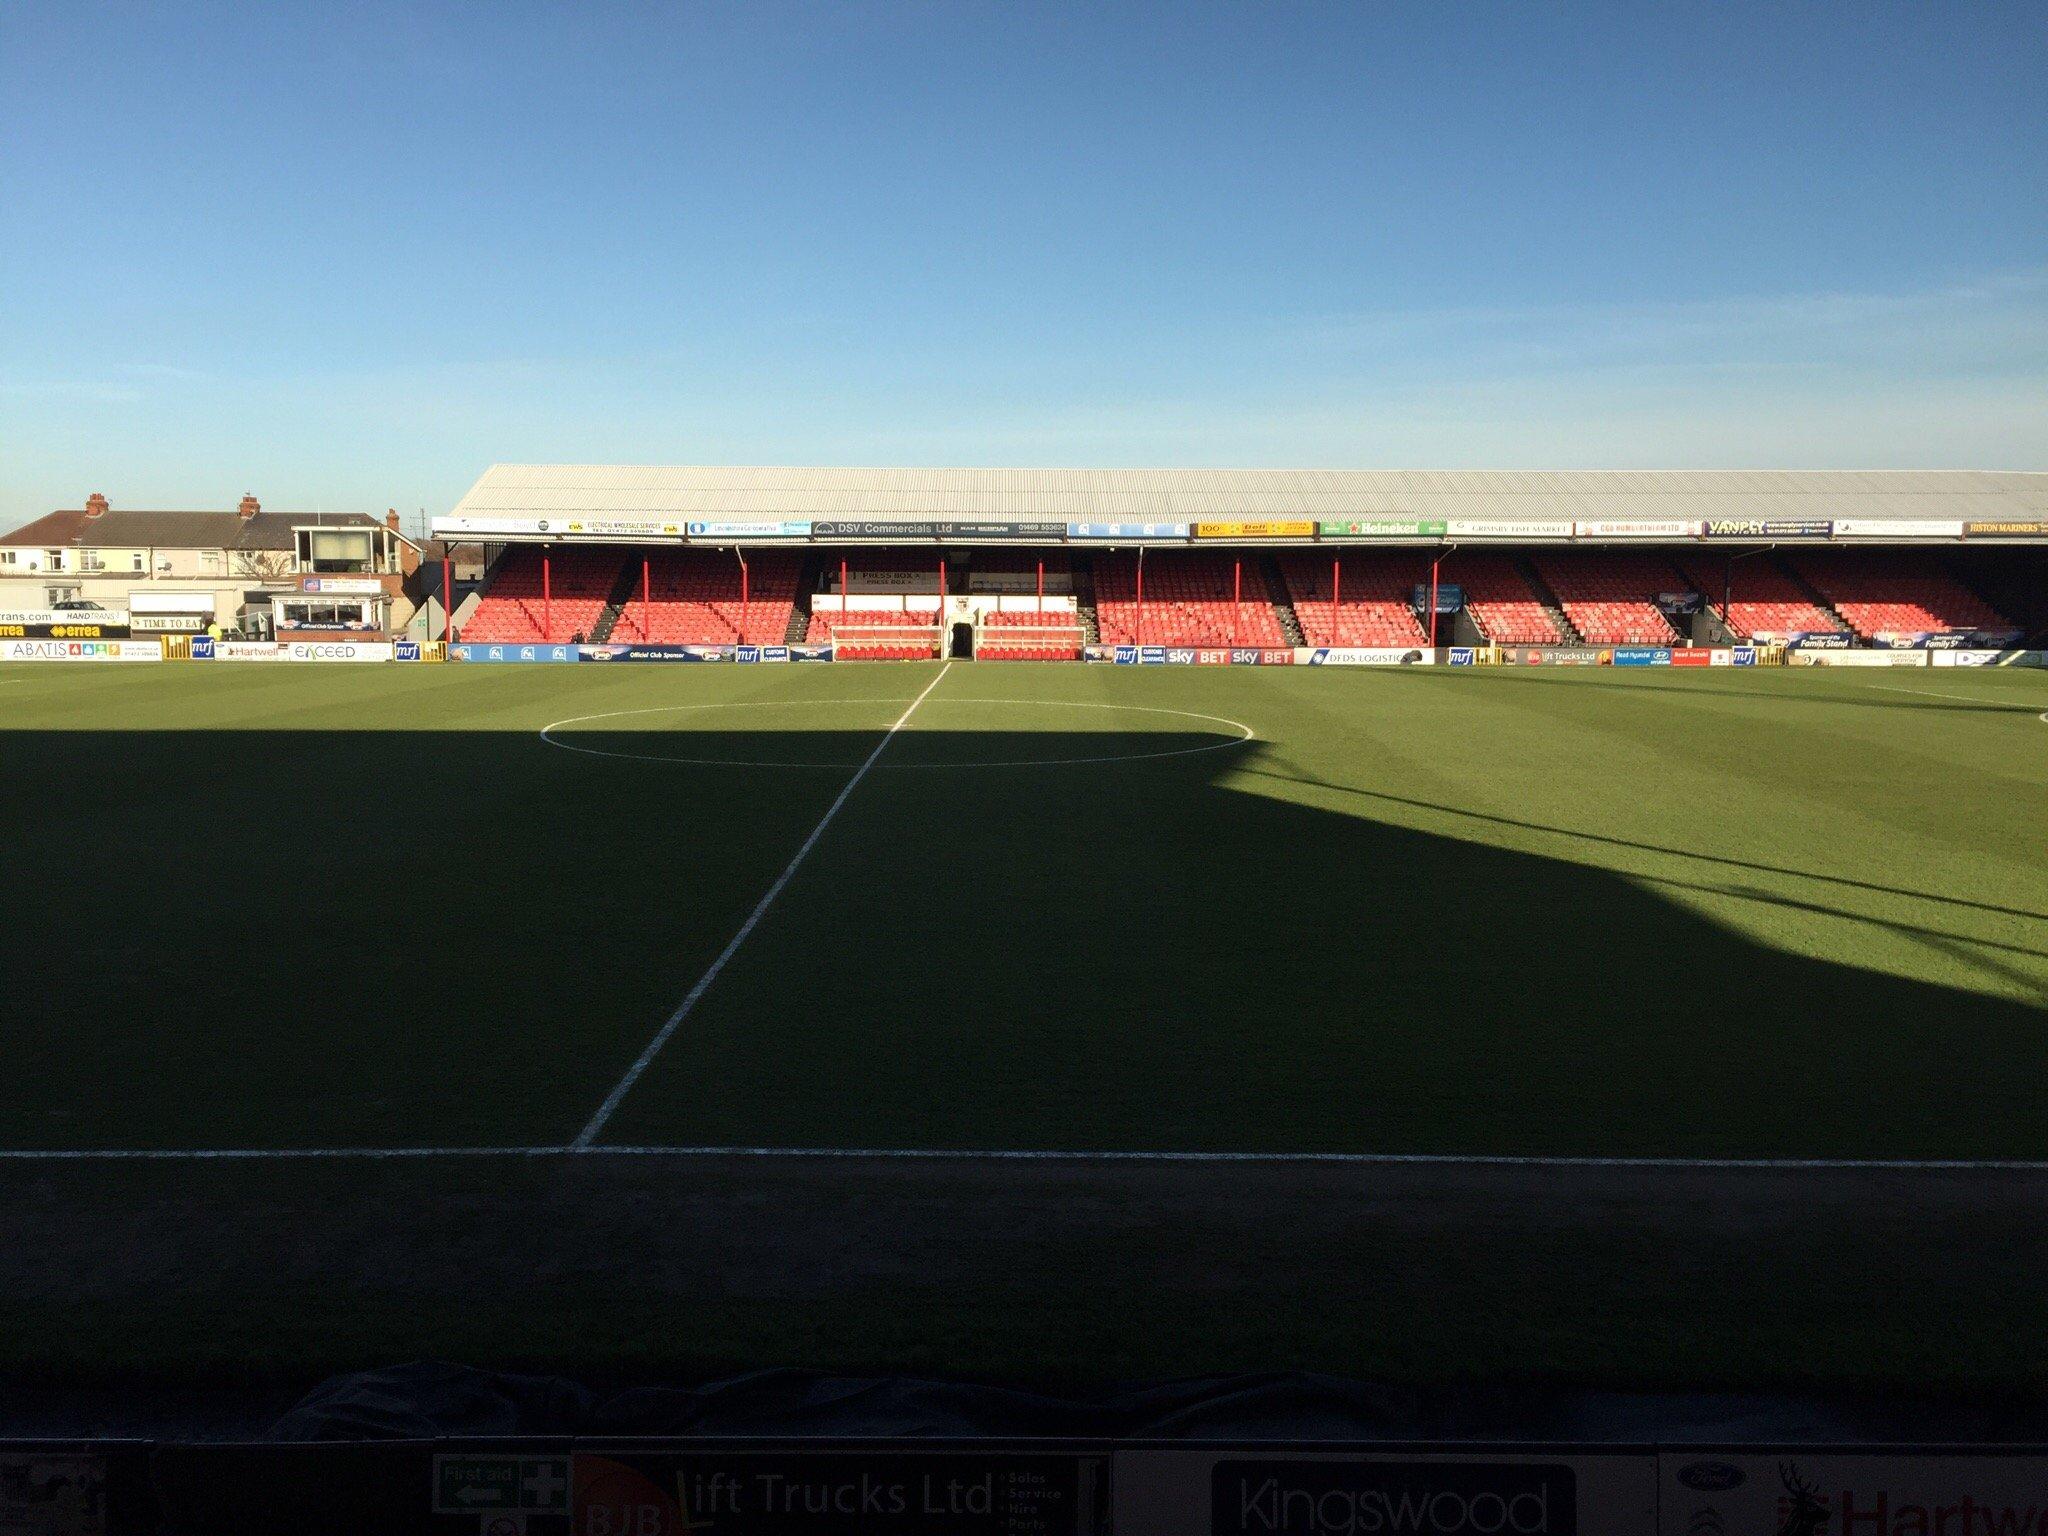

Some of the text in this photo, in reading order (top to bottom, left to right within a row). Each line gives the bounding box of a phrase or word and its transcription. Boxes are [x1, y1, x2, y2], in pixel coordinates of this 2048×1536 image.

[838, 523, 952, 533] DSV Commercials Ltd
[1361, 522, 1419, 534] Heineken
[1472, 525, 1507, 533] GRIMSBY
[1709, 521, 1764, 531] VANPLY
[1970, 523, 1998, 532] HISTON
[2000, 523, 2038, 532] MARINERS
[0, 612, 52, 621] rans.com
[144, 619, 164, 628] TIME
[169, 619, 182, 628] TO
[66, 626, 100, 637] errea
[13, 643, 66, 656] ABATIS
[192, 640, 214, 656] mrf
[1801, 640, 1825, 648] Family
[1925, 640, 1950, 648] Family
[236, 648, 278, 657] Hartwell
[397, 644, 419, 659] mrf
[738, 648, 759, 662] mrf
[1116, 649, 1137, 663] mrf
[1168, 650, 1227, 664] sky BET
[1232, 650, 1291, 664] sky BET
[1555, 652, 1580, 660] Trucks
[1581, 652, 1595, 660] Ltd
[1733, 650, 1755, 664] mrf
[1330, 654, 1356, 662] DFDS
[1450, 651, 1472, 665] mrf
[1008, 1472, 1046, 1484] Sales
[676, 1470, 992, 1528] Lift Trucks Ltd
[1009, 1503, 1038, 1514] Hire
[1240, 1478, 1546, 1536] Kingswood
[586, 1503, 661, 1536] BJB
